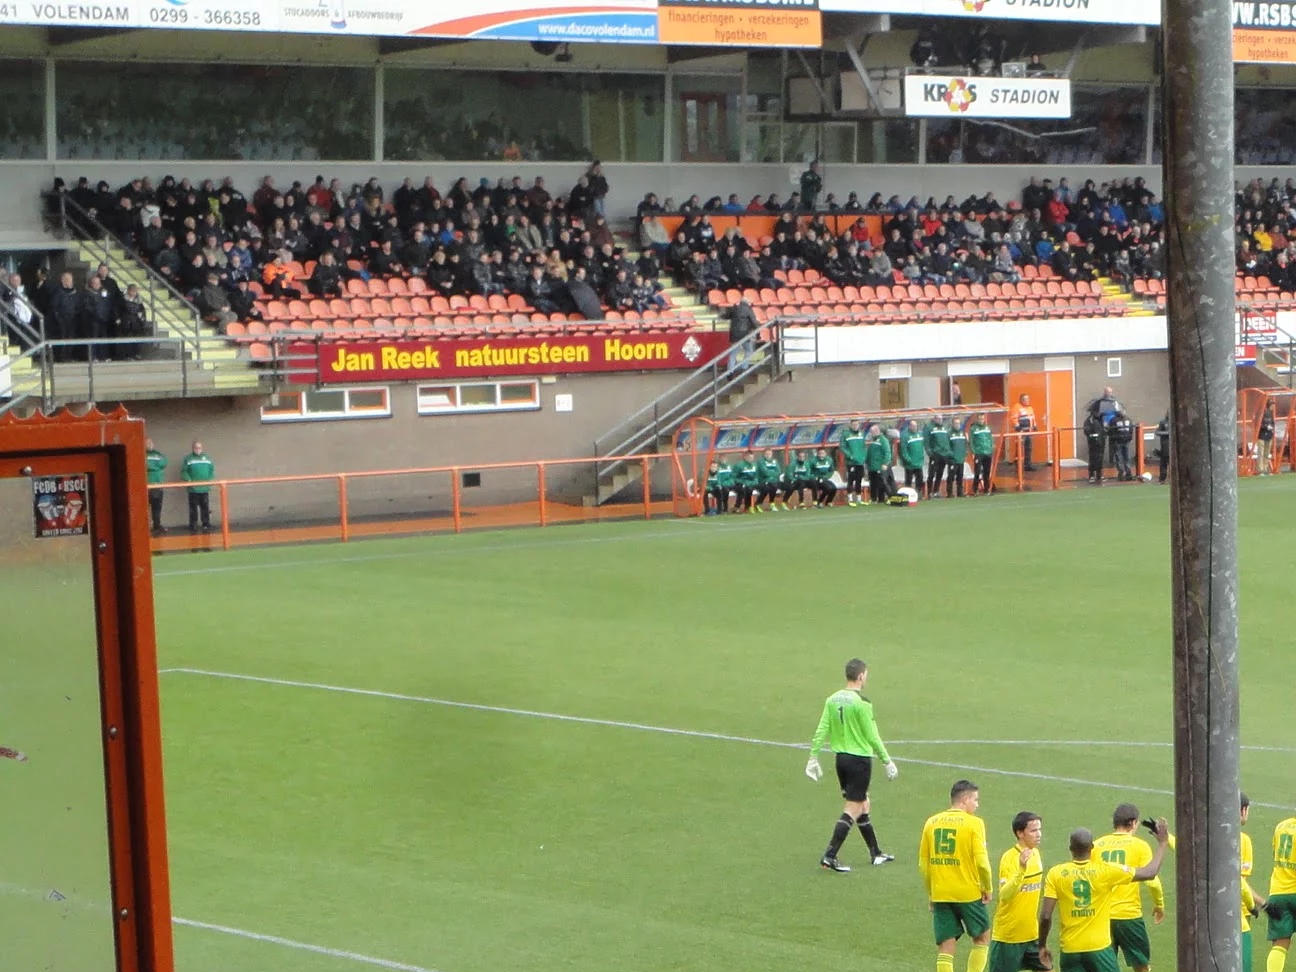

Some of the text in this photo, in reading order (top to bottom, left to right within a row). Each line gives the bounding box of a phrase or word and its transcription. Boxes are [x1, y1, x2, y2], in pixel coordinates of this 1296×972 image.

[32, 5, 130, 21] VOLENDAM
[150, 8, 188, 23] 0299
[204, 10, 261, 25] 366358
[668, 11, 809, 27] financieringen verzekeringen
[538, 22, 655, 37] www.dacovolendam.nl
[715, 27, 767, 41] hypotheken
[1248, 48, 1289, 59] hypotheken
[990, 89, 1060, 104] STADION
[331, 339, 668, 372] Jan Reek natuursteen Hoorn
[933, 827, 957, 855] 15
[1072, 879, 1092, 908] 9
